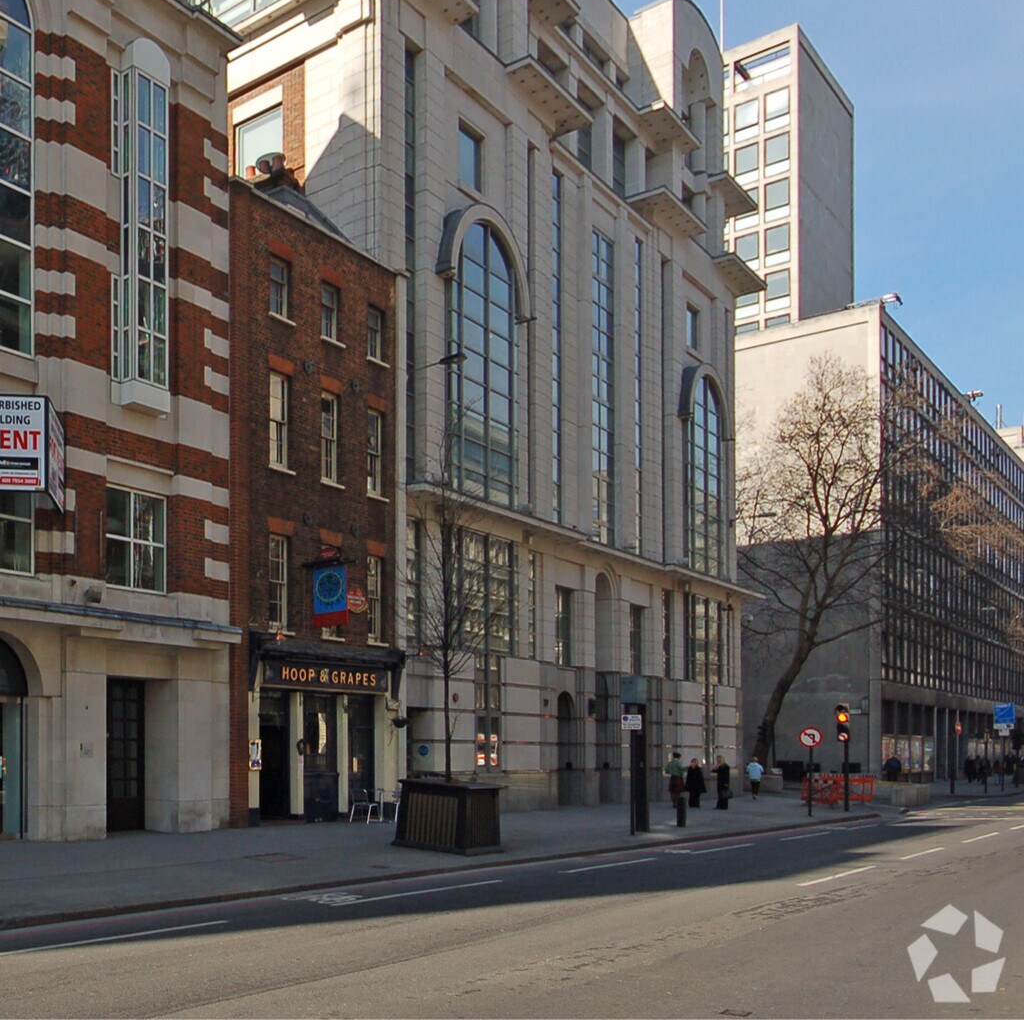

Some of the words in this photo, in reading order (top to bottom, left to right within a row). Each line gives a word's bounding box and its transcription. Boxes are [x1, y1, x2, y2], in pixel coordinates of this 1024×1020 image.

[282, 667, 315, 682] HOOP
[319, 669, 327, 682] &
[332, 671, 377, 686] GRAPES
